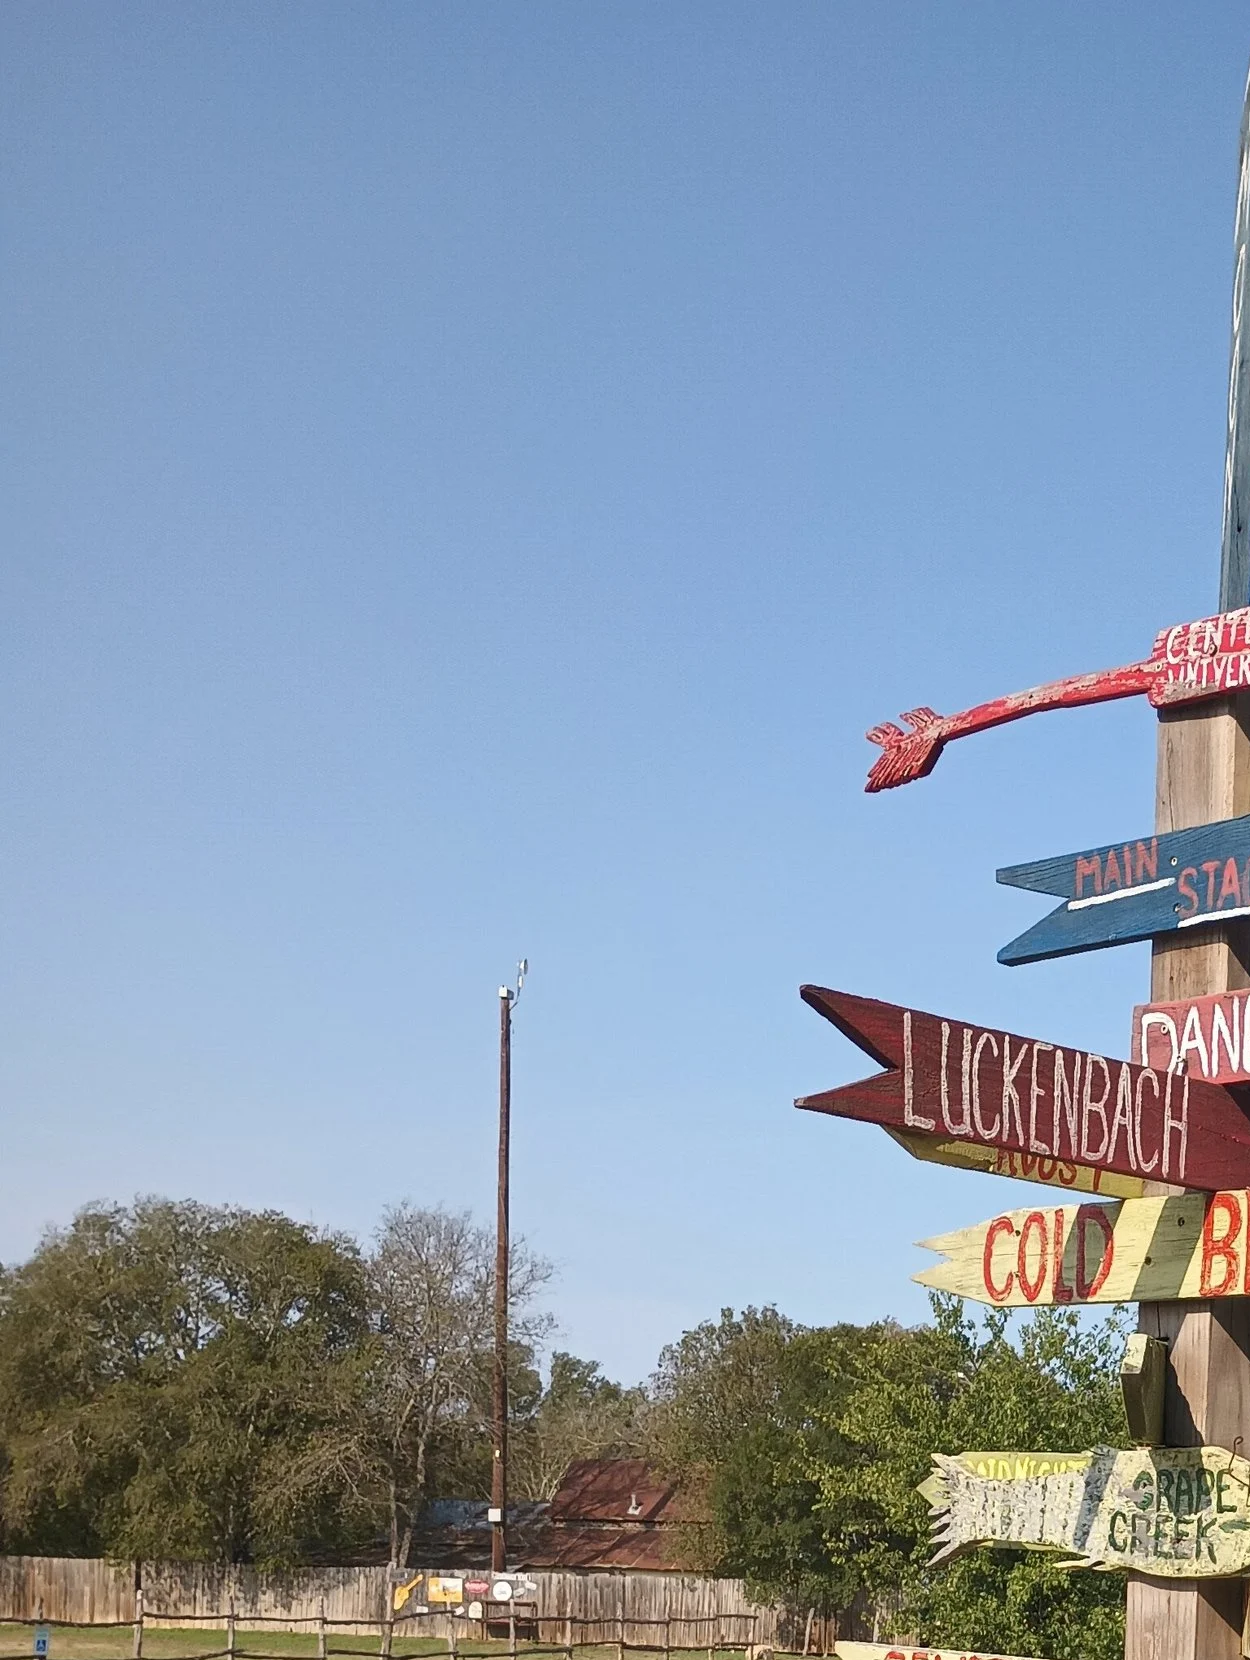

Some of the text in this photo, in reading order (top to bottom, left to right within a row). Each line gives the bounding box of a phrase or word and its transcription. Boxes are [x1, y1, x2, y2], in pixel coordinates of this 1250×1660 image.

[1074, 837, 1159, 898] MAIN
[903, 1010, 1189, 1180] LUCKENBACH
[983, 1204, 1114, 1304] COLD
[1133, 1467, 1238, 1517] GRAPE
[1108, 1510, 1218, 1565] CREEK
